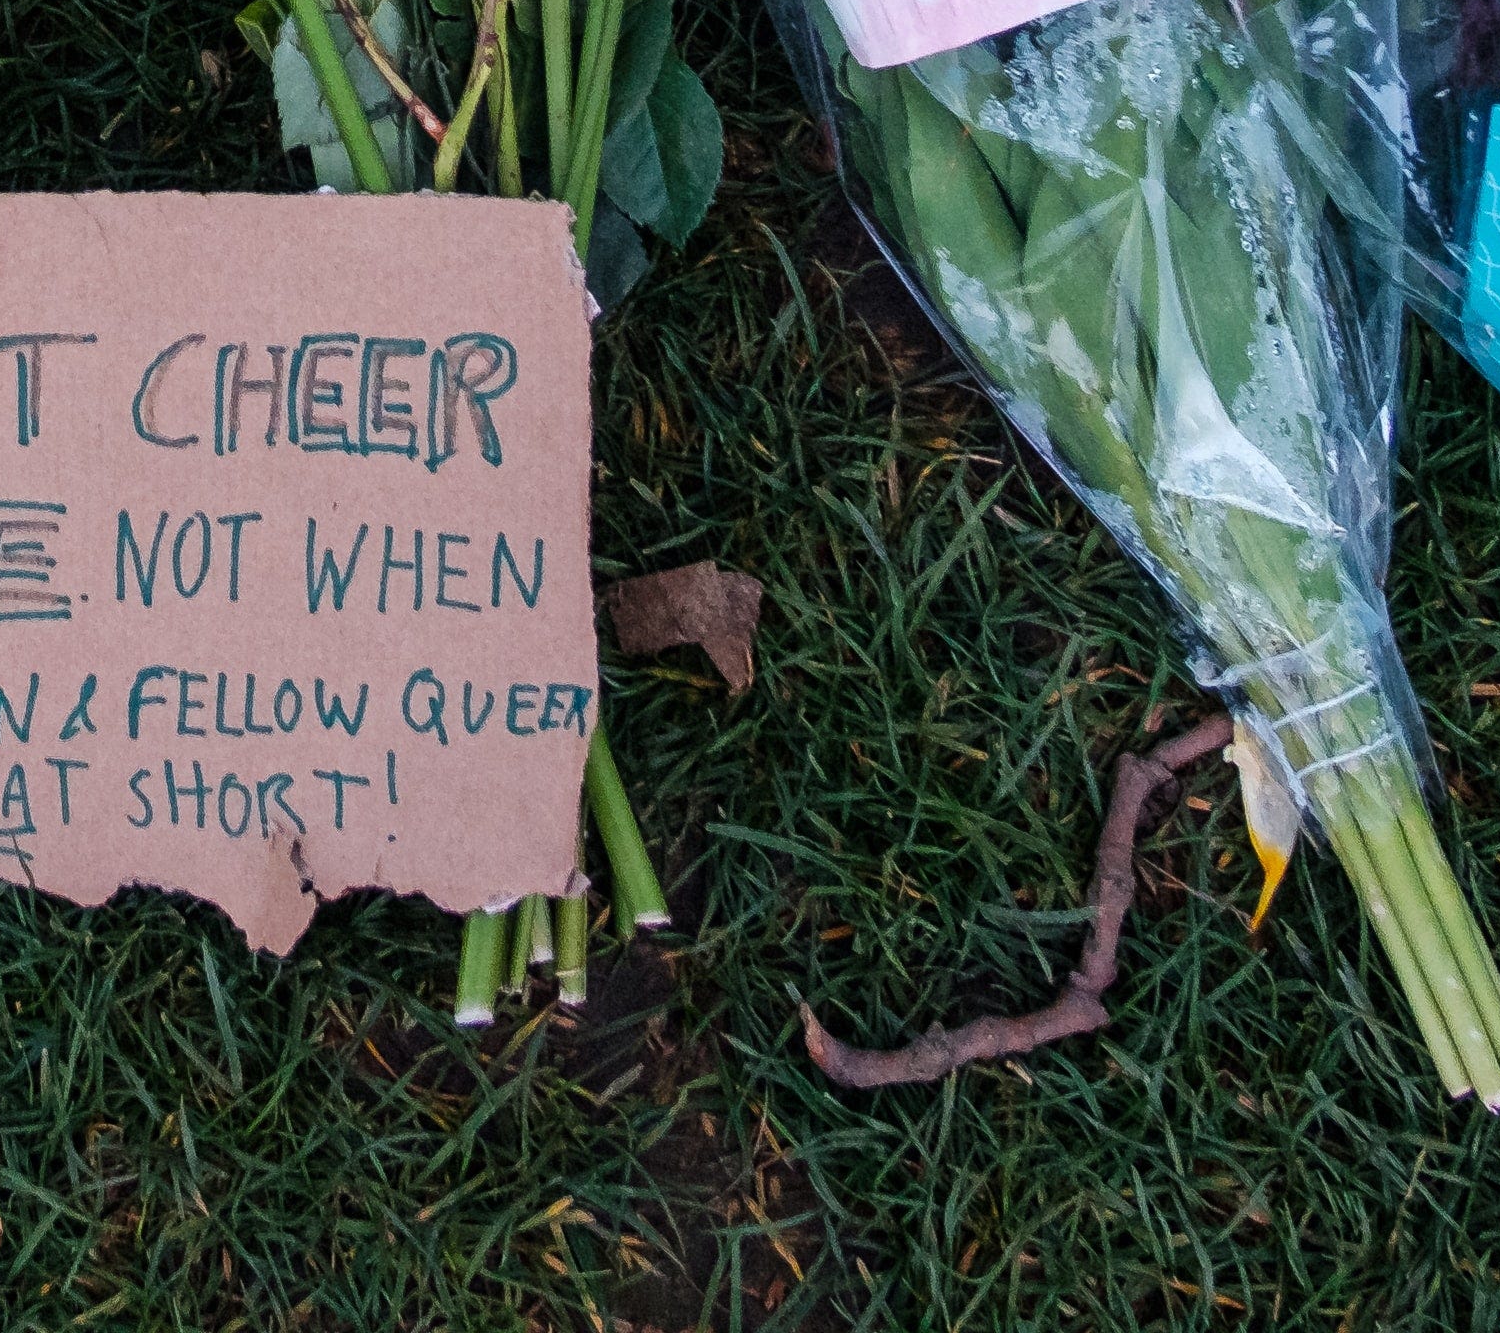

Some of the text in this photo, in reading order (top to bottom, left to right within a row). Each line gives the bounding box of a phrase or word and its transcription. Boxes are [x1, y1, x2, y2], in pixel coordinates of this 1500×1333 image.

[131, 331, 520, 471] CHEER
[114, 508, 263, 609] NOT
[304, 518, 546, 615] WHEN
[127, 663, 371, 740] FELLOW
[399, 666, 596, 746] QUEER
[124, 748, 400, 845] SHORT!
